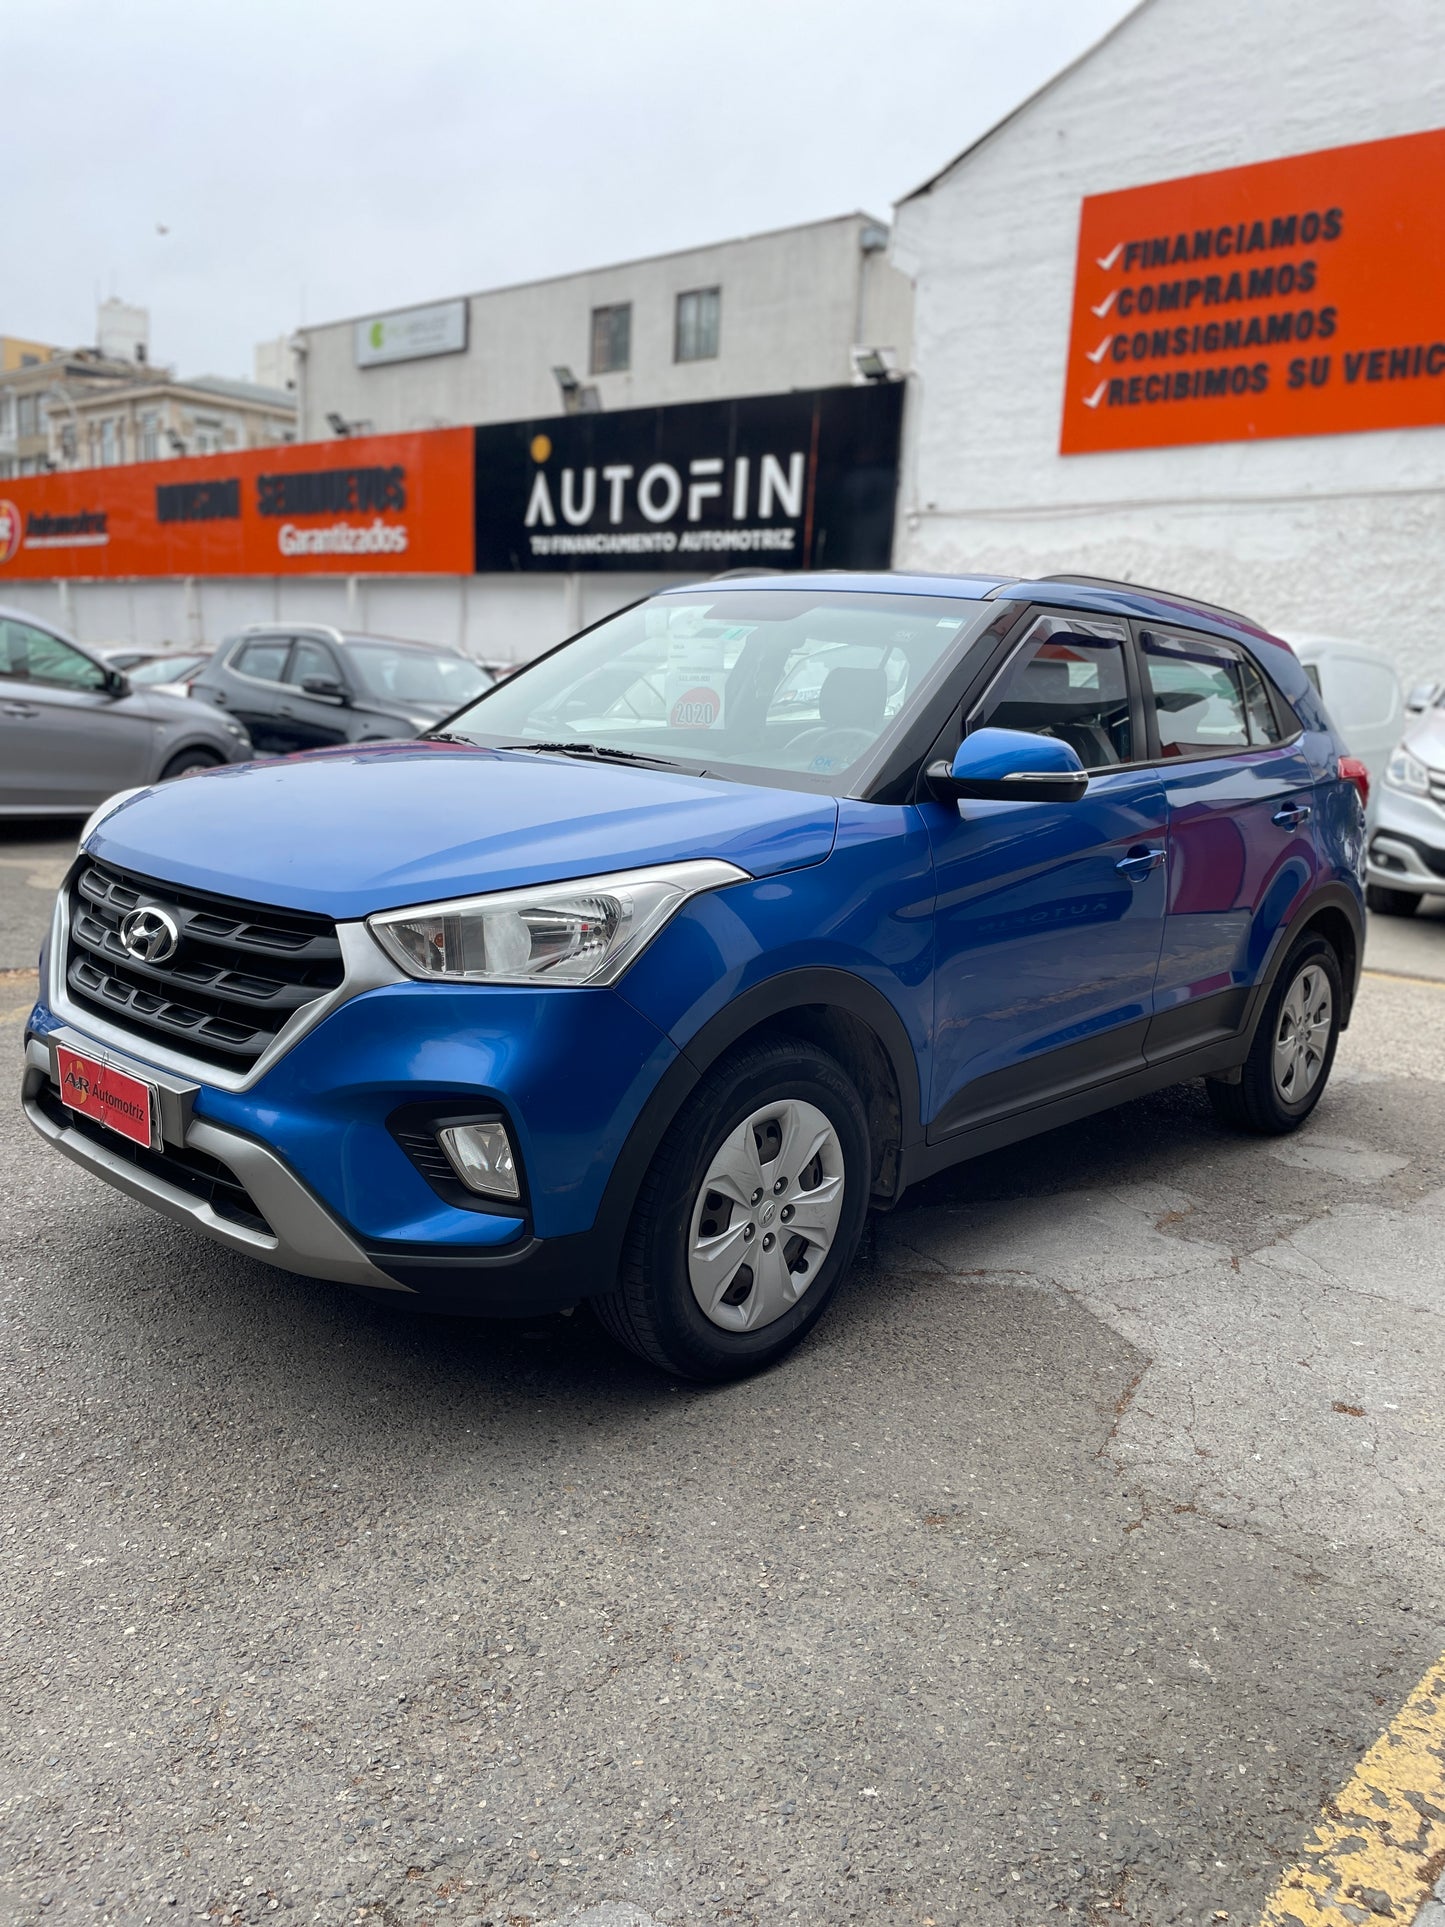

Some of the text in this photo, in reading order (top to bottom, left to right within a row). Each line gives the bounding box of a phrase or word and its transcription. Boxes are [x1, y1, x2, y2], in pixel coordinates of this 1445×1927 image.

[1122, 208, 1343, 273] FINANCIAMOS
[1117, 261, 1317, 317] COMPRAMOS
[1111, 307, 1338, 364] CONSIGNAMOS
[1108, 363, 1269, 407] RECIBIMOS
[1287, 355, 1331, 390] SU
[524, 452, 805, 527] AUTOFIN
[278, 519, 407, 556] Garantizados
[530, 528, 795, 554] TU FINANCIAMENTO AUTOMOTRIZ
[676, 703, 713, 725] 2020
[91, 1084, 145, 1122] Automotriz
